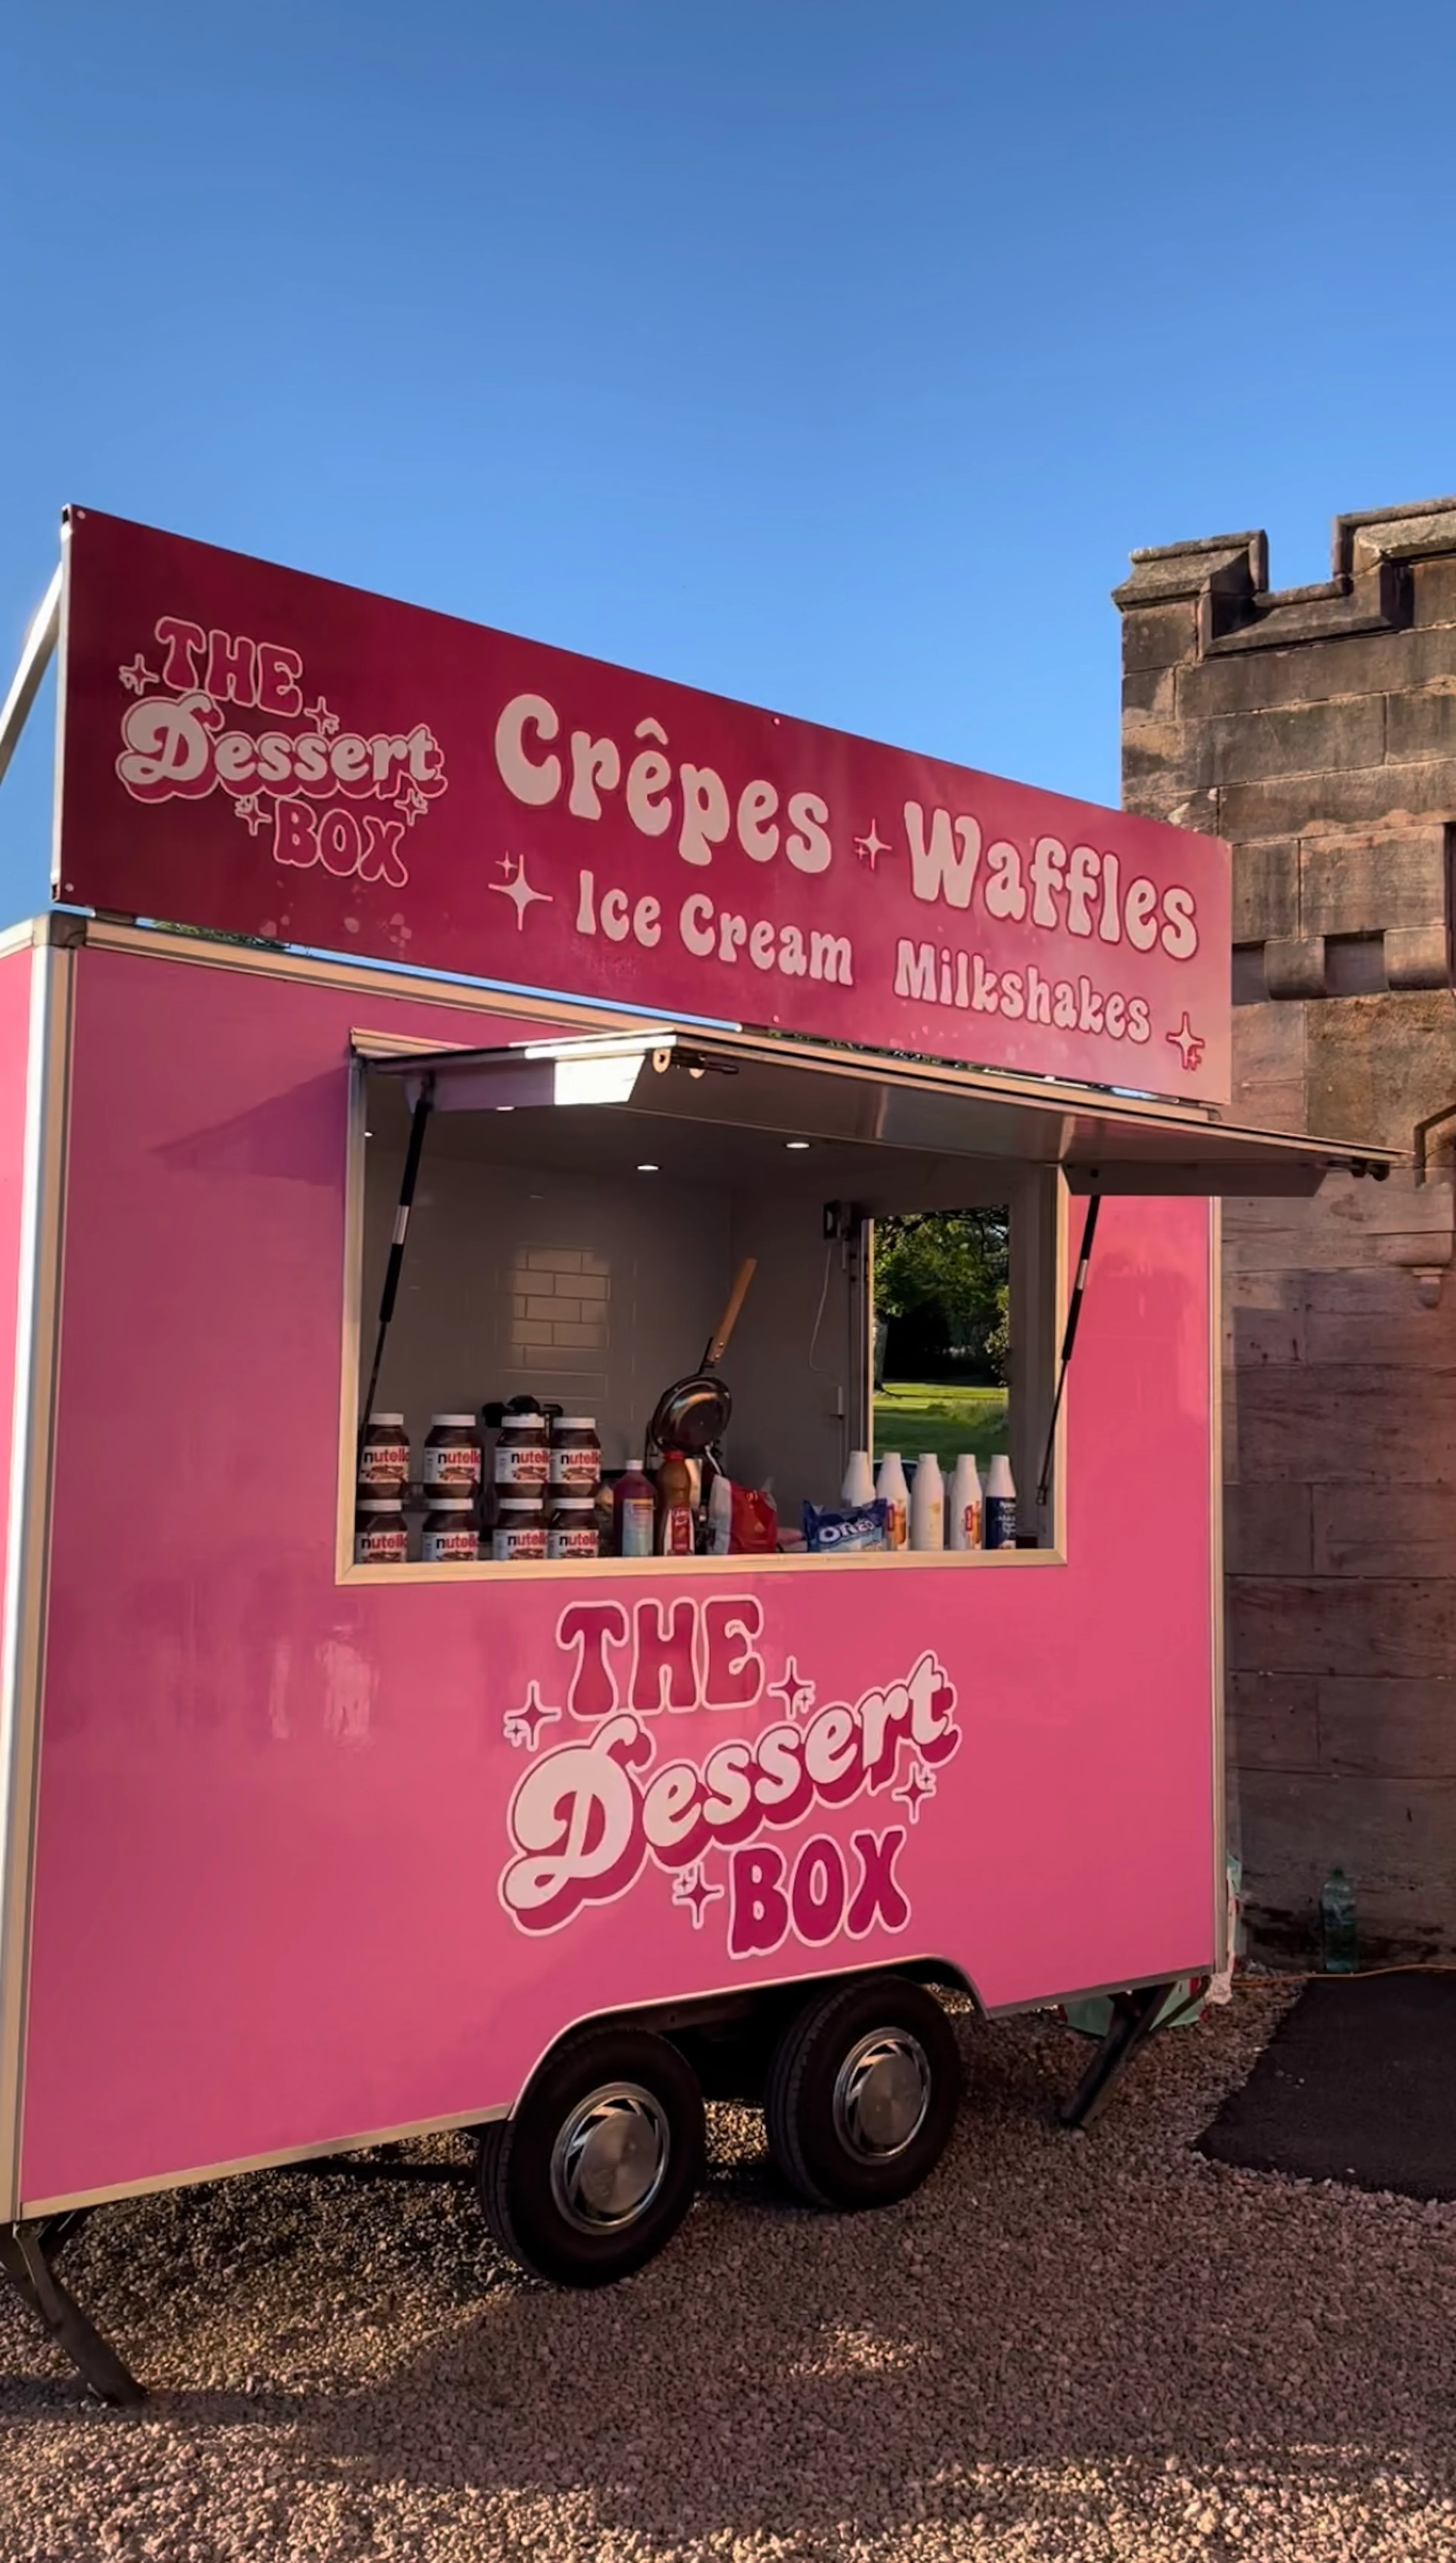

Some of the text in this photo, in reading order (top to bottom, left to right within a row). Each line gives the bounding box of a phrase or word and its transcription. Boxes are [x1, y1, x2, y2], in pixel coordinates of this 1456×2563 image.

[155, 616, 302, 717] THE
[115, 690, 448, 803] Dessert
[273, 798, 408, 888] BOX
[495, 694, 1198, 960] Crêpes Waffles
[576, 869, 1151, 1043] Ice Cream Milkshakes
[556, 1594, 763, 1721] THE
[499, 1649, 961, 1936] Dessert
[727, 1825, 910, 1960] BOX
